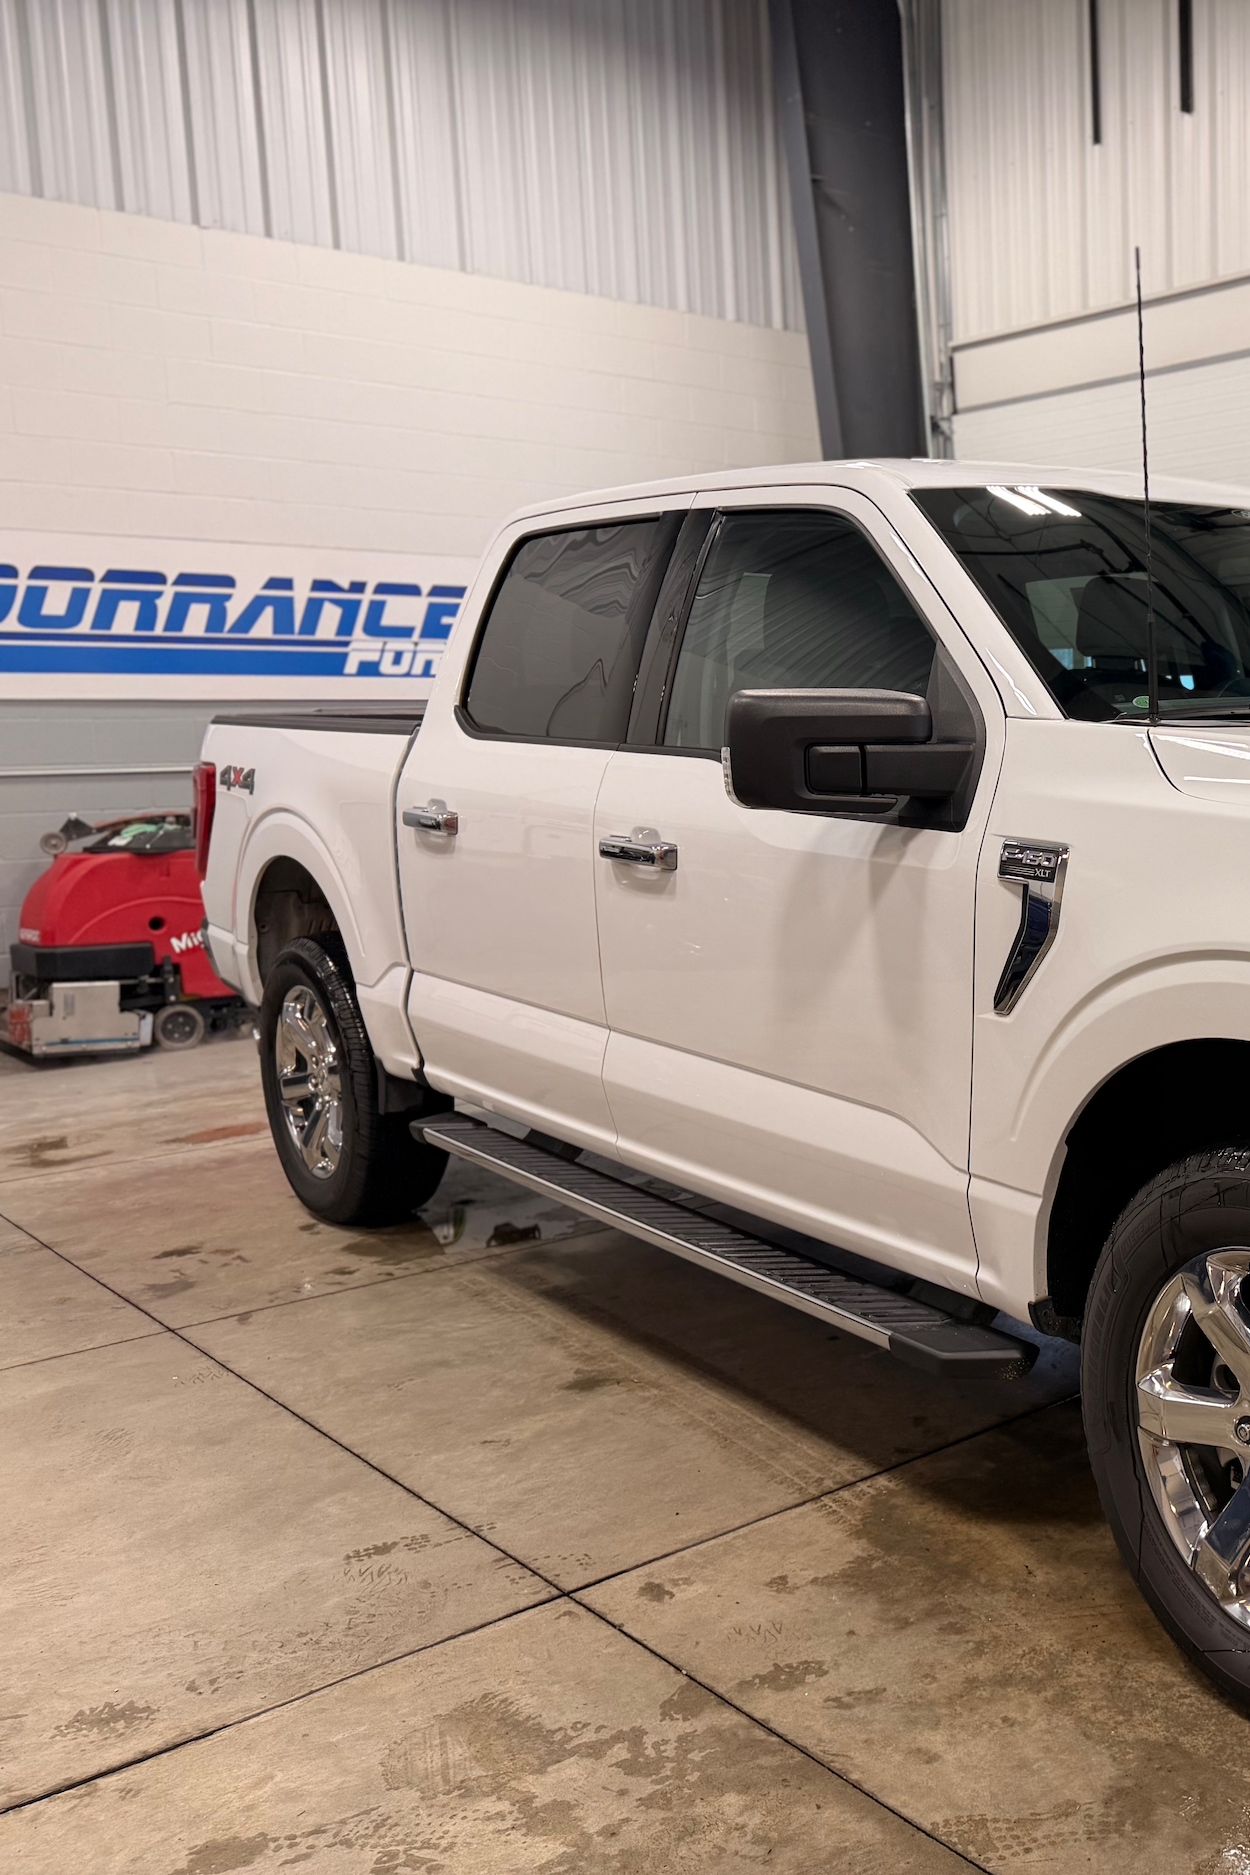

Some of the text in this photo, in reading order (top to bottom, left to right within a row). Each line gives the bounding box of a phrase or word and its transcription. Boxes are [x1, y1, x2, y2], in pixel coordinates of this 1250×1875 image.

[1001, 847, 1057, 868] F-150
[1034, 868, 1051, 878] XLT
[1123, 1208, 1164, 1252] DEFENDE
